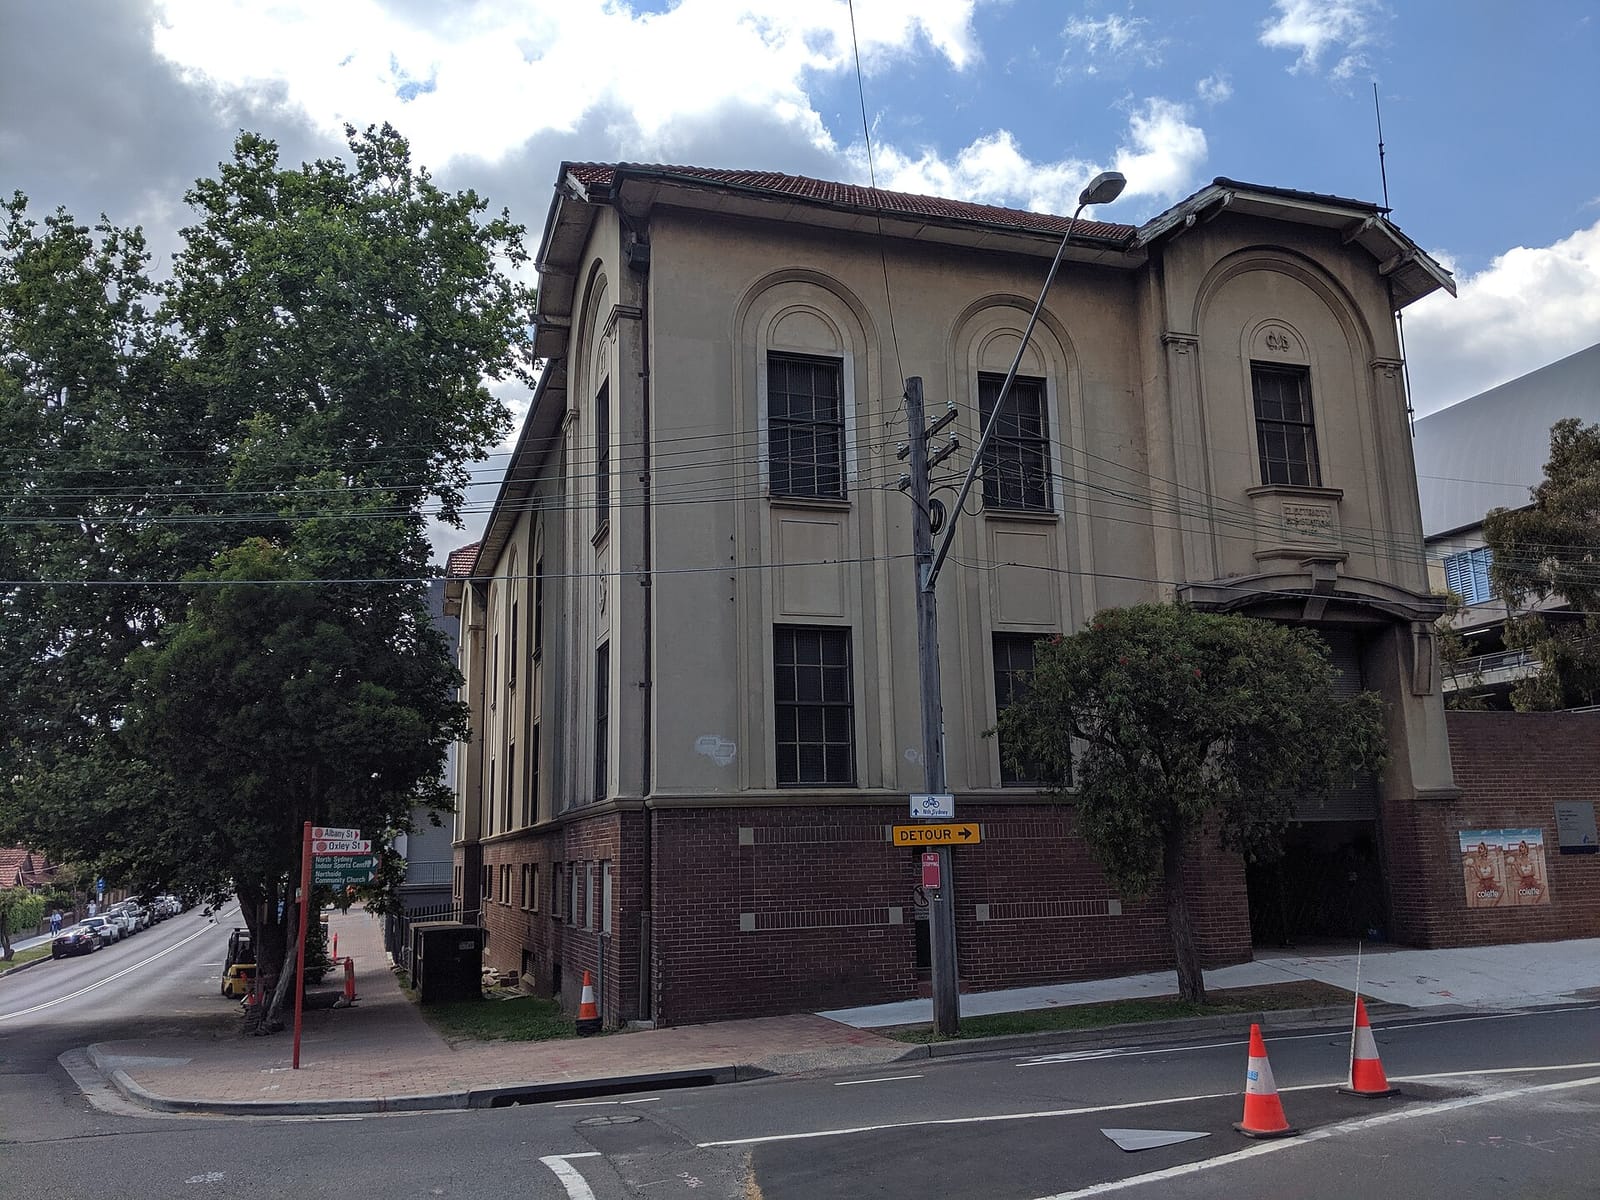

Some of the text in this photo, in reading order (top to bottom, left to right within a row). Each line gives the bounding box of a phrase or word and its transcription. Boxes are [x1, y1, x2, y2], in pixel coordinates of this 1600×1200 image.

[324, 828, 353, 839] Albany St
[900, 829, 952, 841] DETOUR
[329, 841, 361, 851] Oxley St
[333, 855, 353, 863] Sydney
[333, 862, 352, 870] Sports
[314, 877, 346, 885] Community
[1477, 889, 1499, 898] colette
[1519, 887, 1541, 896] colette
